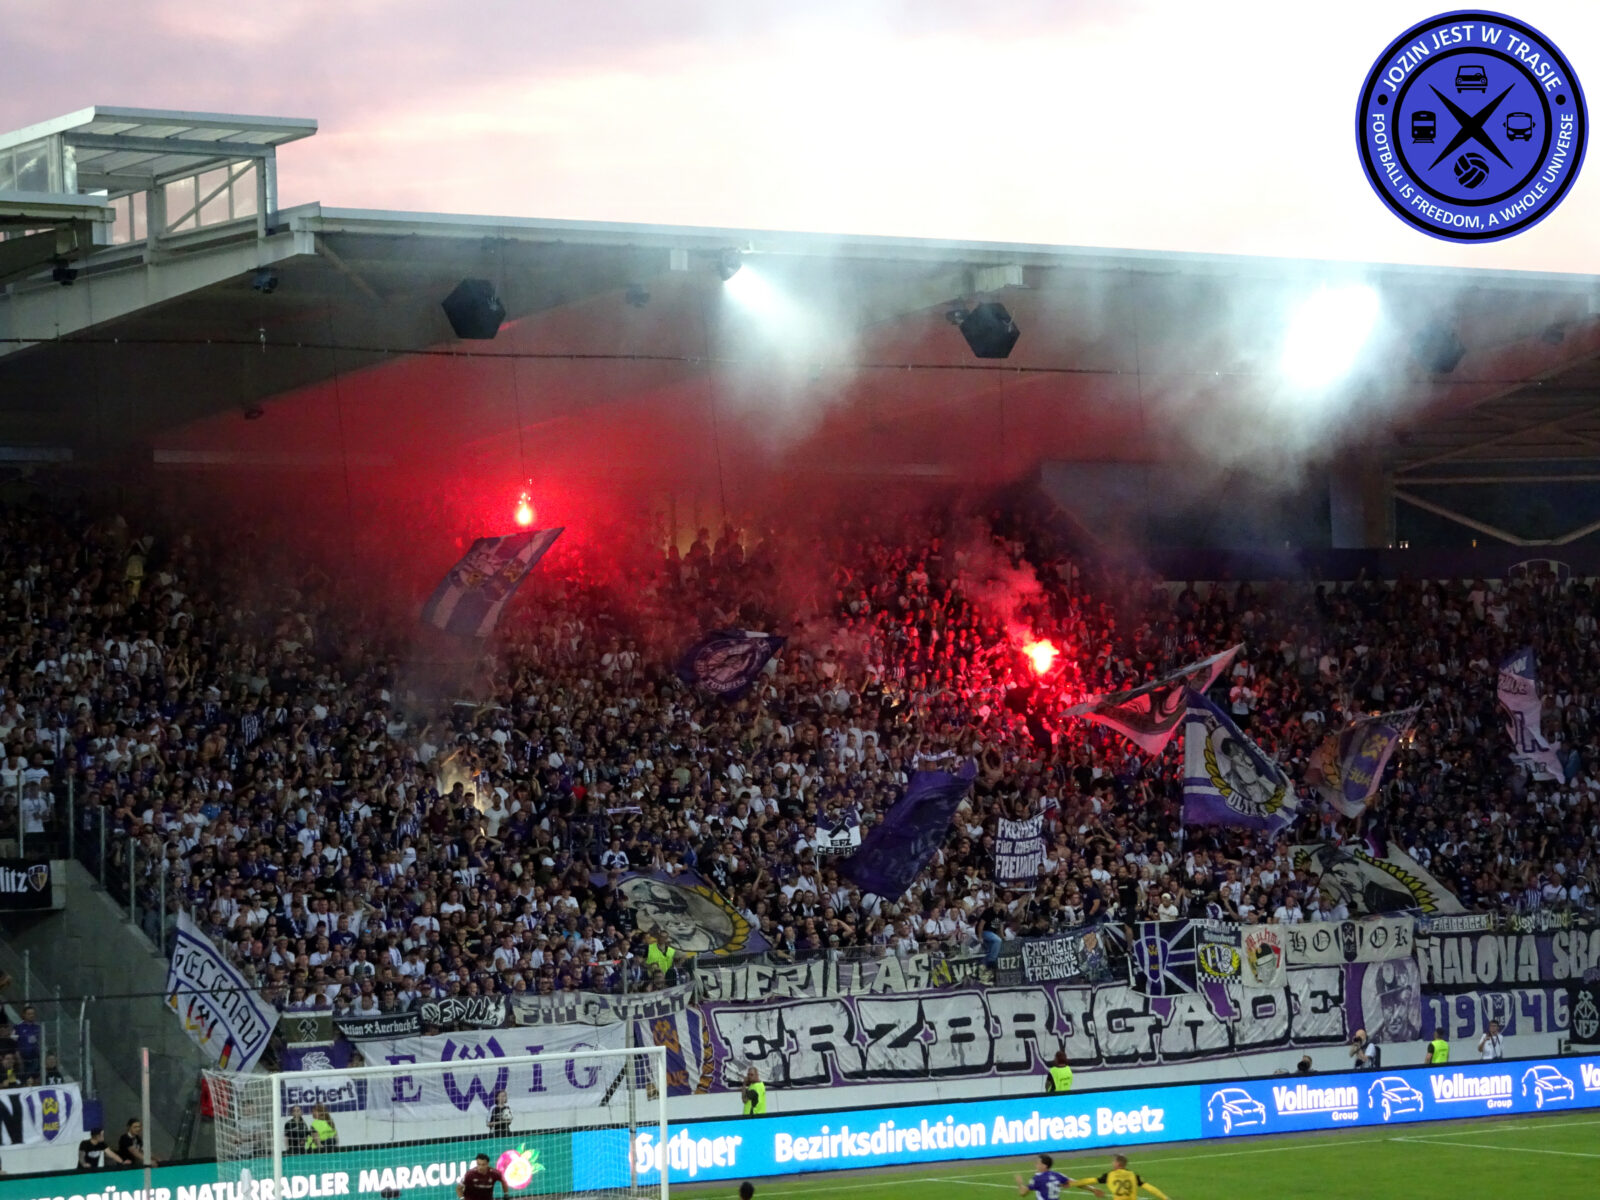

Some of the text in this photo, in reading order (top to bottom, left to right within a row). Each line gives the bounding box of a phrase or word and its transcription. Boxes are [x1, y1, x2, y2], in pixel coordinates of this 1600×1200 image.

[1024, 936, 1074, 957] FREIHEIT
[1027, 961, 1080, 982] FREUNDE
[714, 966, 1345, 1087] ERZBRIGADE
[287, 1081, 355, 1104] Eichert
[1272, 1084, 1358, 1111] Vollmann
[1430, 1073, 1512, 1099] Vollmann
[1332, 1110, 1359, 1121] Group
[1487, 1098, 1512, 1109] Group
[775, 1115, 985, 1163] Bezirksdirektion
[991, 1110, 1091, 1145] Andreas
[1097, 1105, 1165, 1136] Beetz
[358, 1160, 477, 1193] MARACUJ
